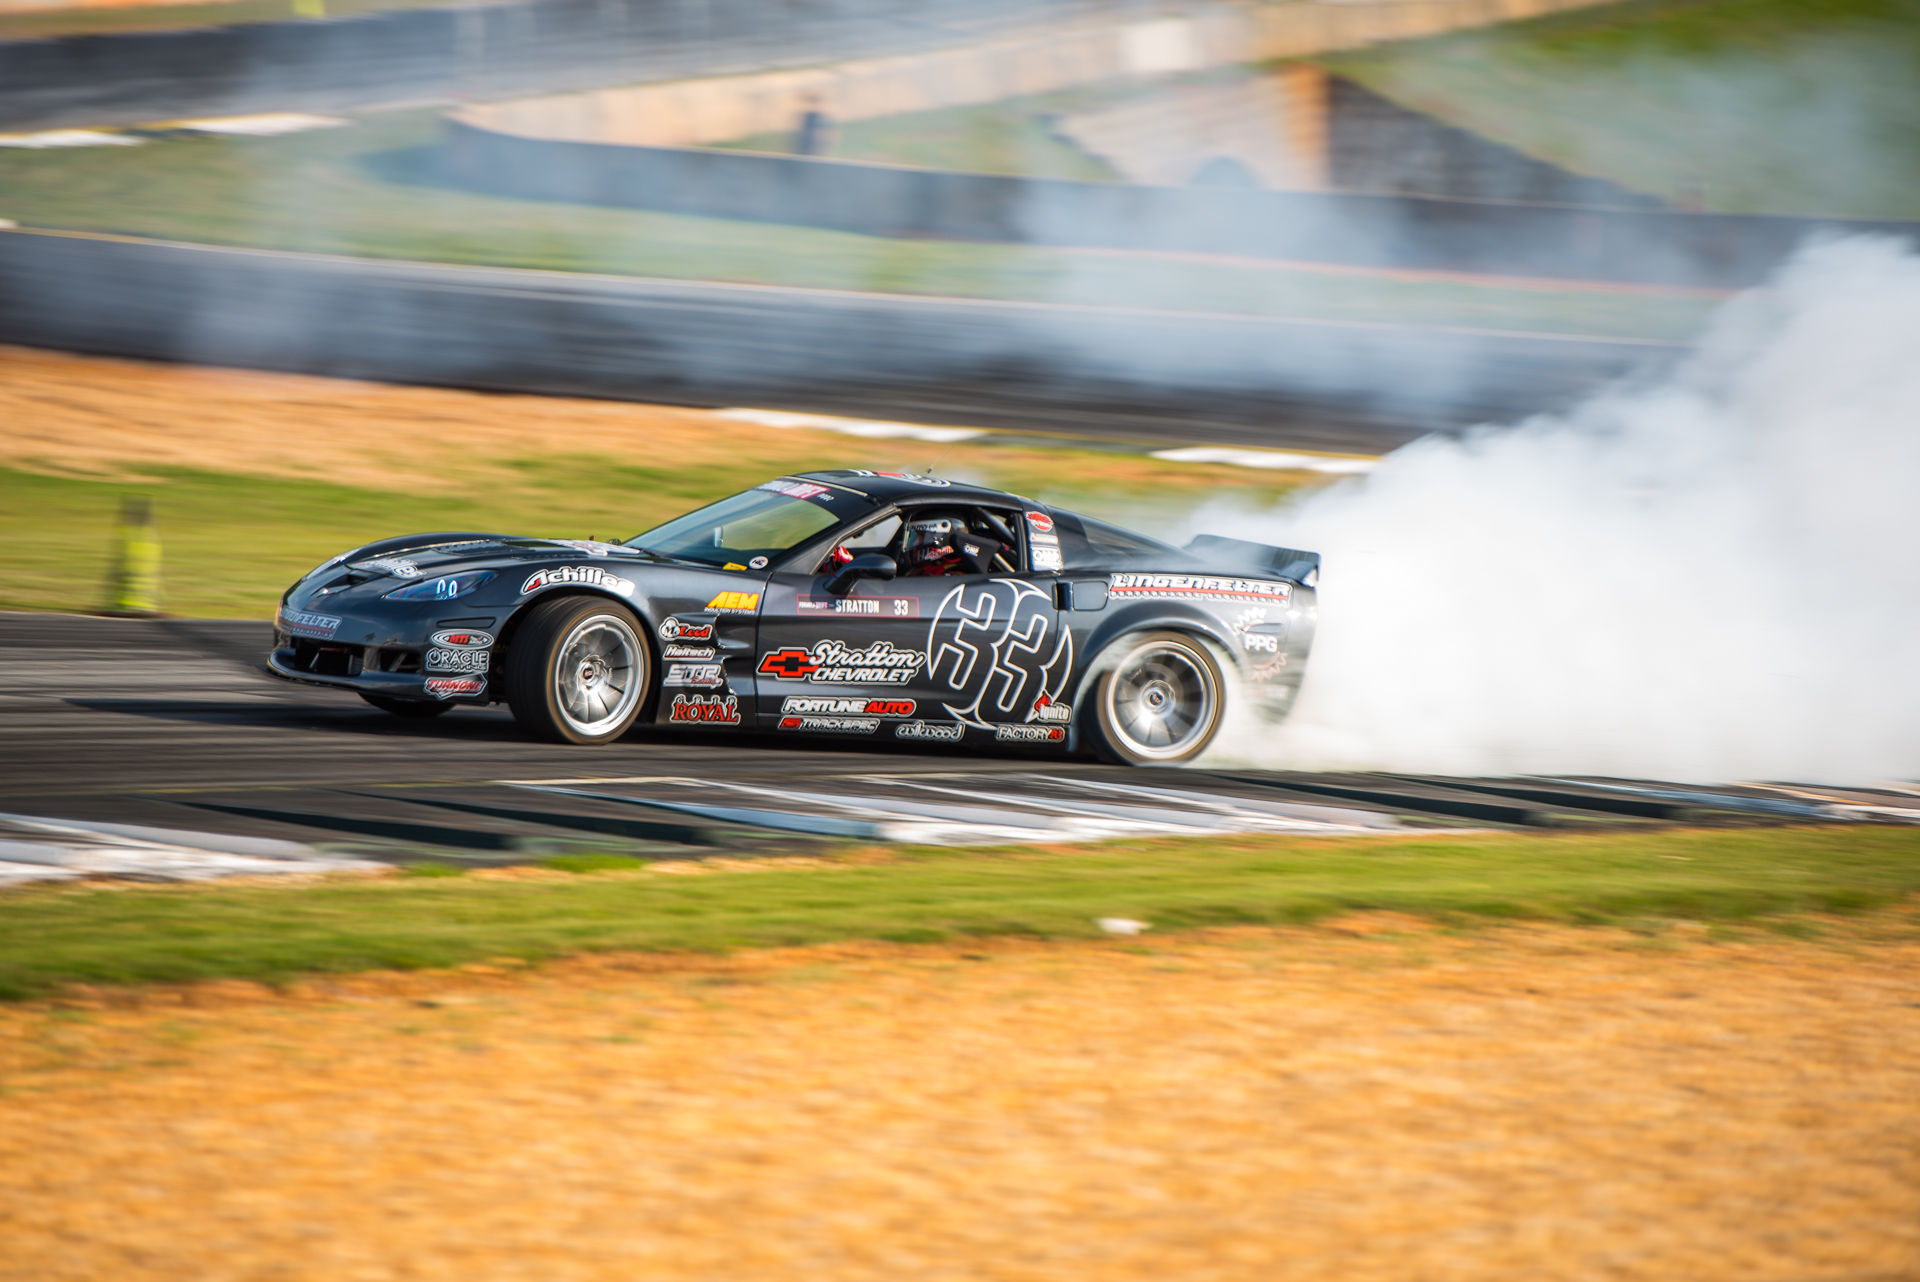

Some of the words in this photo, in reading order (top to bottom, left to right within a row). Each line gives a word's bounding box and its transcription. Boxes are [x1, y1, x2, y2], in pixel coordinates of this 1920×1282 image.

[522, 567, 634, 597] Achilles
[1113, 574, 1290, 597] LINGENFELTER
[707, 591, 760, 610] AEM
[835, 599, 880, 614] STRATTON
[894, 599, 909, 616] 33
[449, 634, 470, 644] MTI
[1244, 634, 1277, 652] PPG
[429, 650, 487, 666] ORACLE
[666, 647, 713, 657] Haltech
[808, 643, 924, 667] Stratton
[812, 668, 915, 682] CHEVROLET
[428, 680, 484, 692] TURNONE
[672, 703, 739, 722] ROYAL
[784, 699, 867, 713] FORTUNE
[865, 701, 914, 714] AUTO
[801, 718, 878, 730] TRACKSPEC
[896, 724, 962, 740] wilwood
